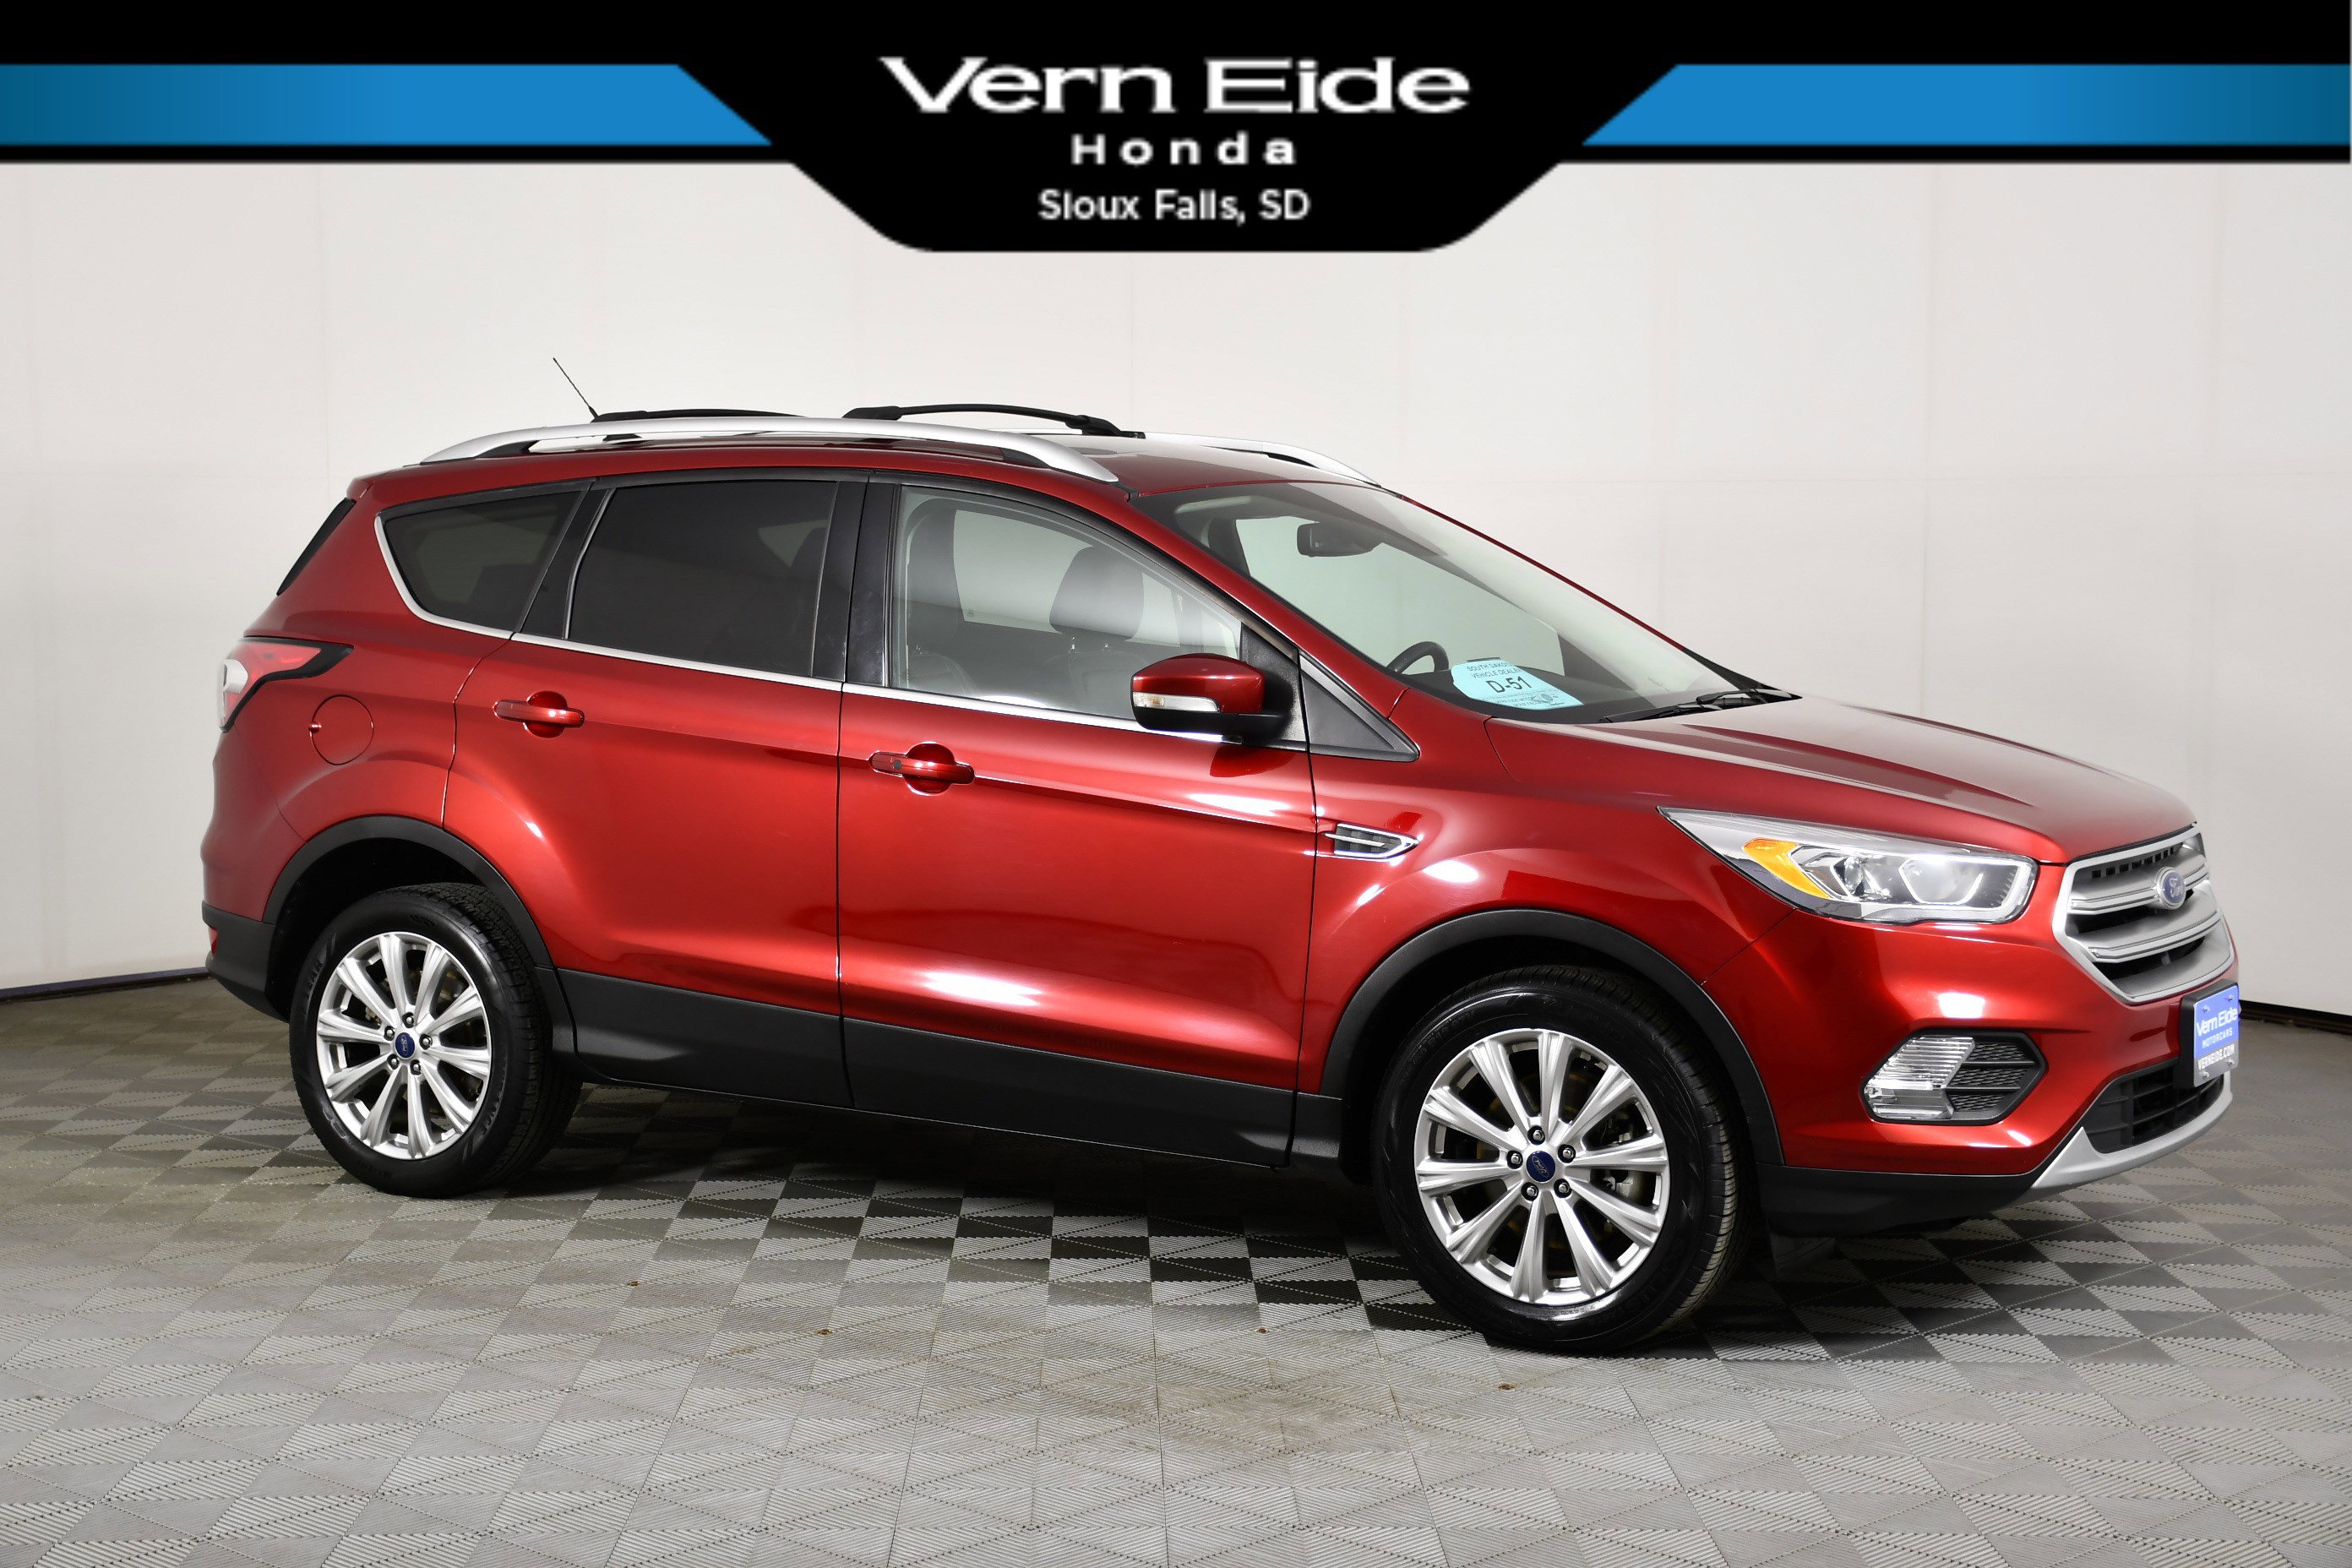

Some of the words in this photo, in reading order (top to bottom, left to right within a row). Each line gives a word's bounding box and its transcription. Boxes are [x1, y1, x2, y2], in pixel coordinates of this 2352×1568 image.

[1485, 676, 1532, 693] D-51
[2197, 1015, 2218, 1037] Vern
[2218, 1007, 2238, 1027] Eide
